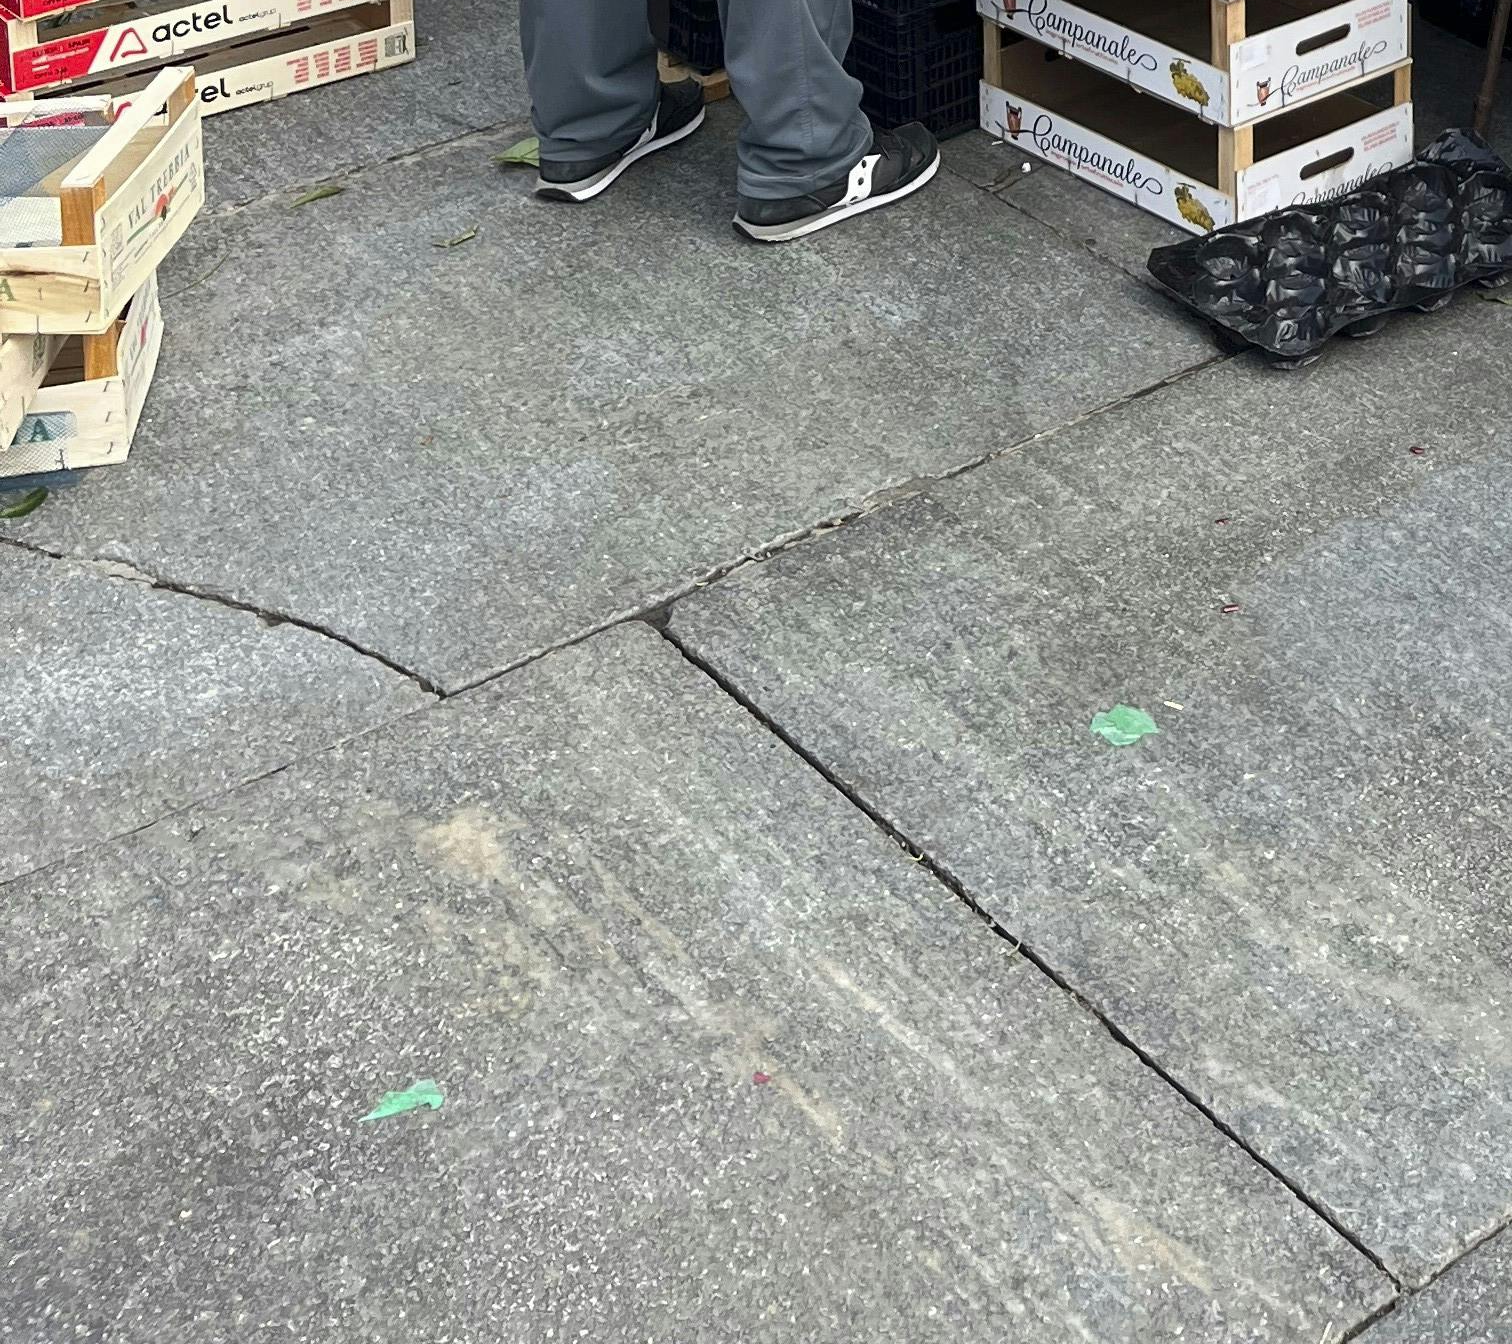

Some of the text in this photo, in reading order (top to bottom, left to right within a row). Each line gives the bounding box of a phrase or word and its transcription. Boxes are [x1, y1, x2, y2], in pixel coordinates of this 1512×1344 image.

[151, 4, 234, 44] actel
[1281, 39, 1388, 98] Campanale
[128, 143, 191, 230] VAL TREBBIA
[1033, 114, 1163, 196] Campanale
